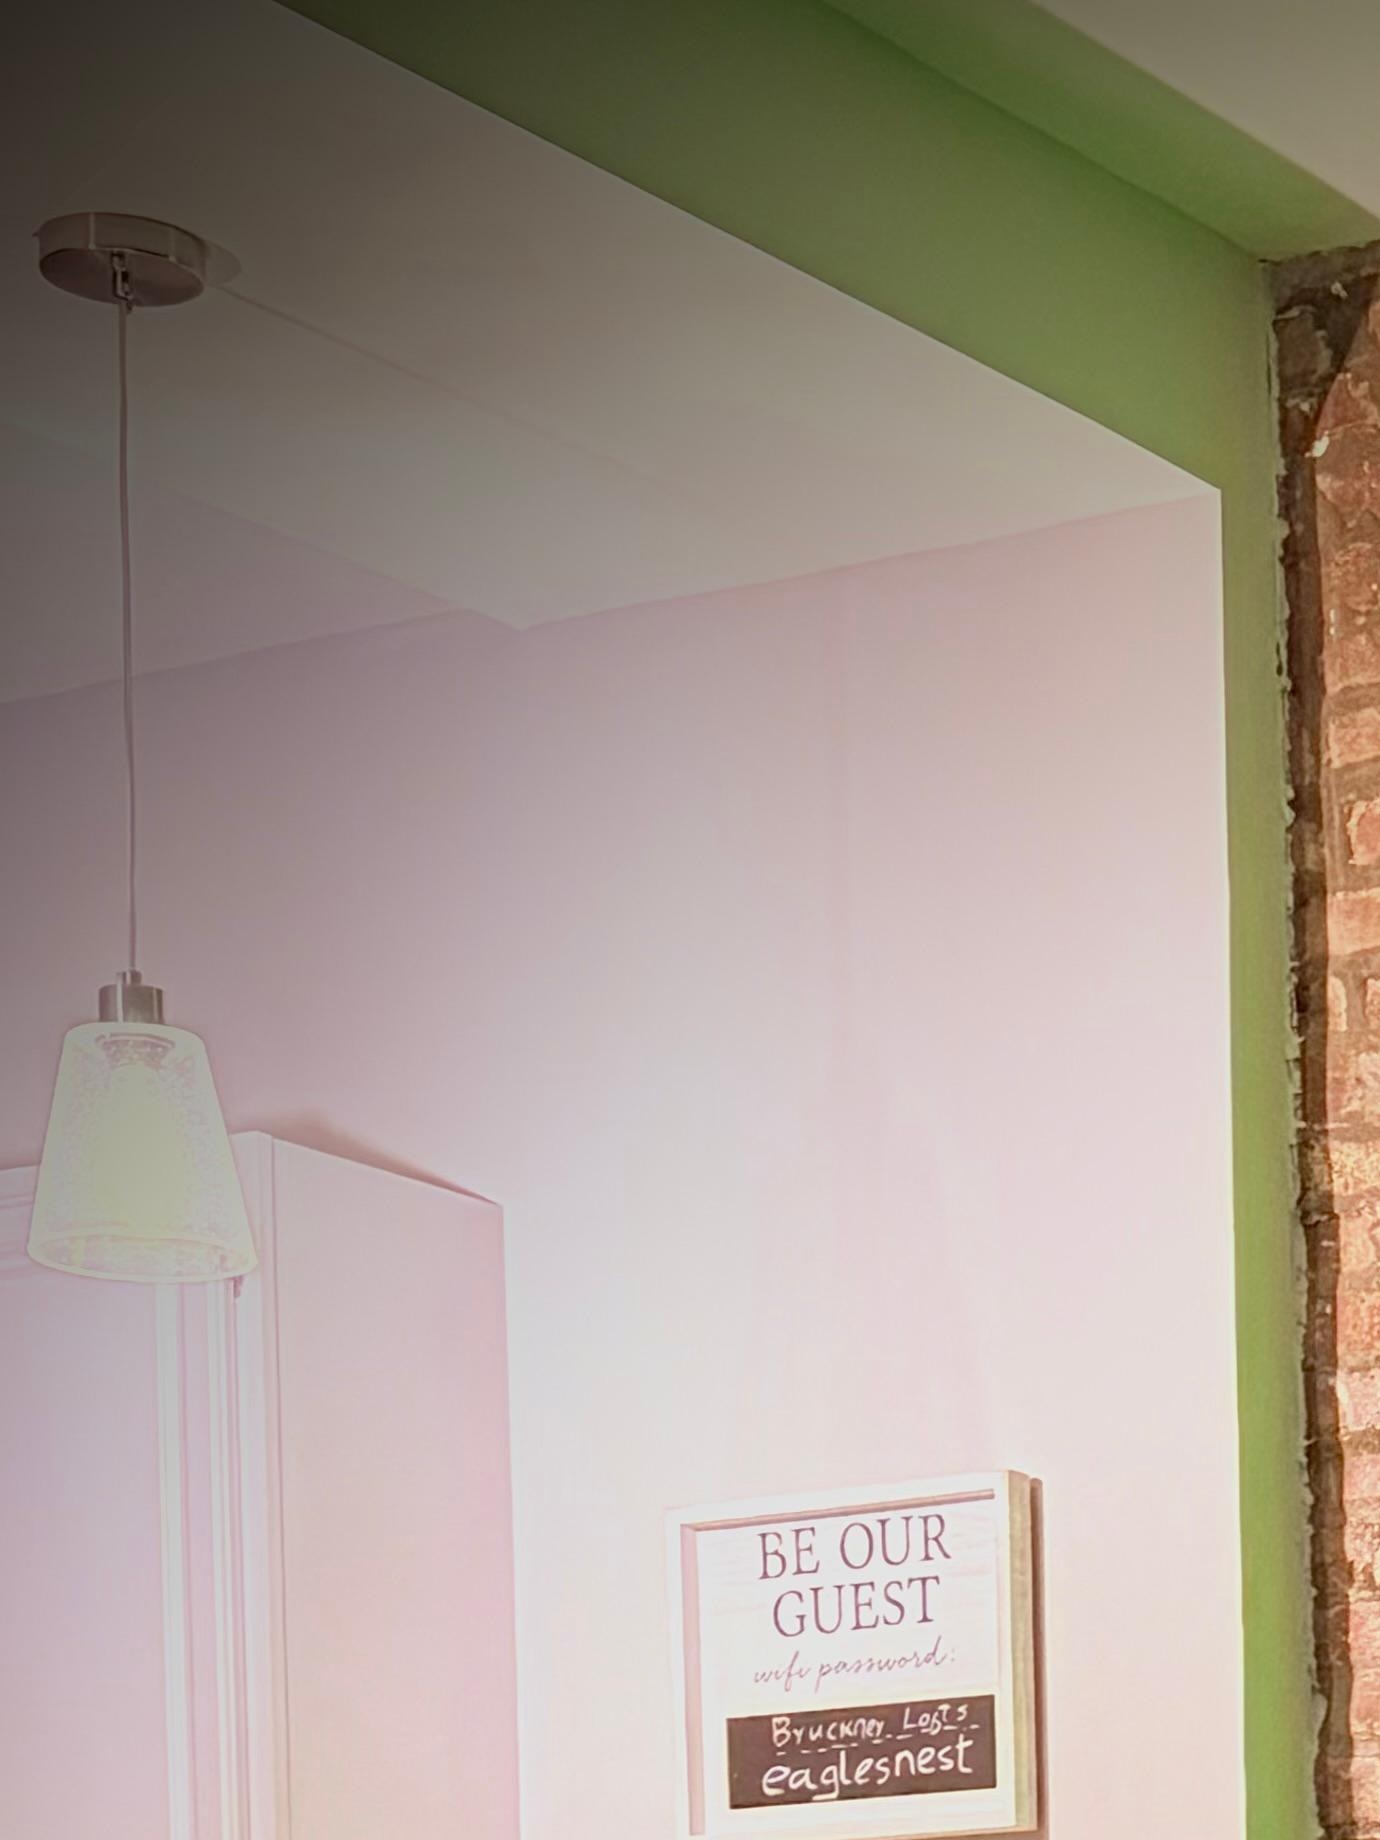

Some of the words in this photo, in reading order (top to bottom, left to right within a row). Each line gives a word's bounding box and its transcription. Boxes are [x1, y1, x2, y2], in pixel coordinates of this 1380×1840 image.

[757, 1526, 821, 1581] BE
[840, 1512, 952, 1571] OUR
[772, 1575, 941, 1638] GUEST
[762, 1733, 974, 1801] eaglesnest
